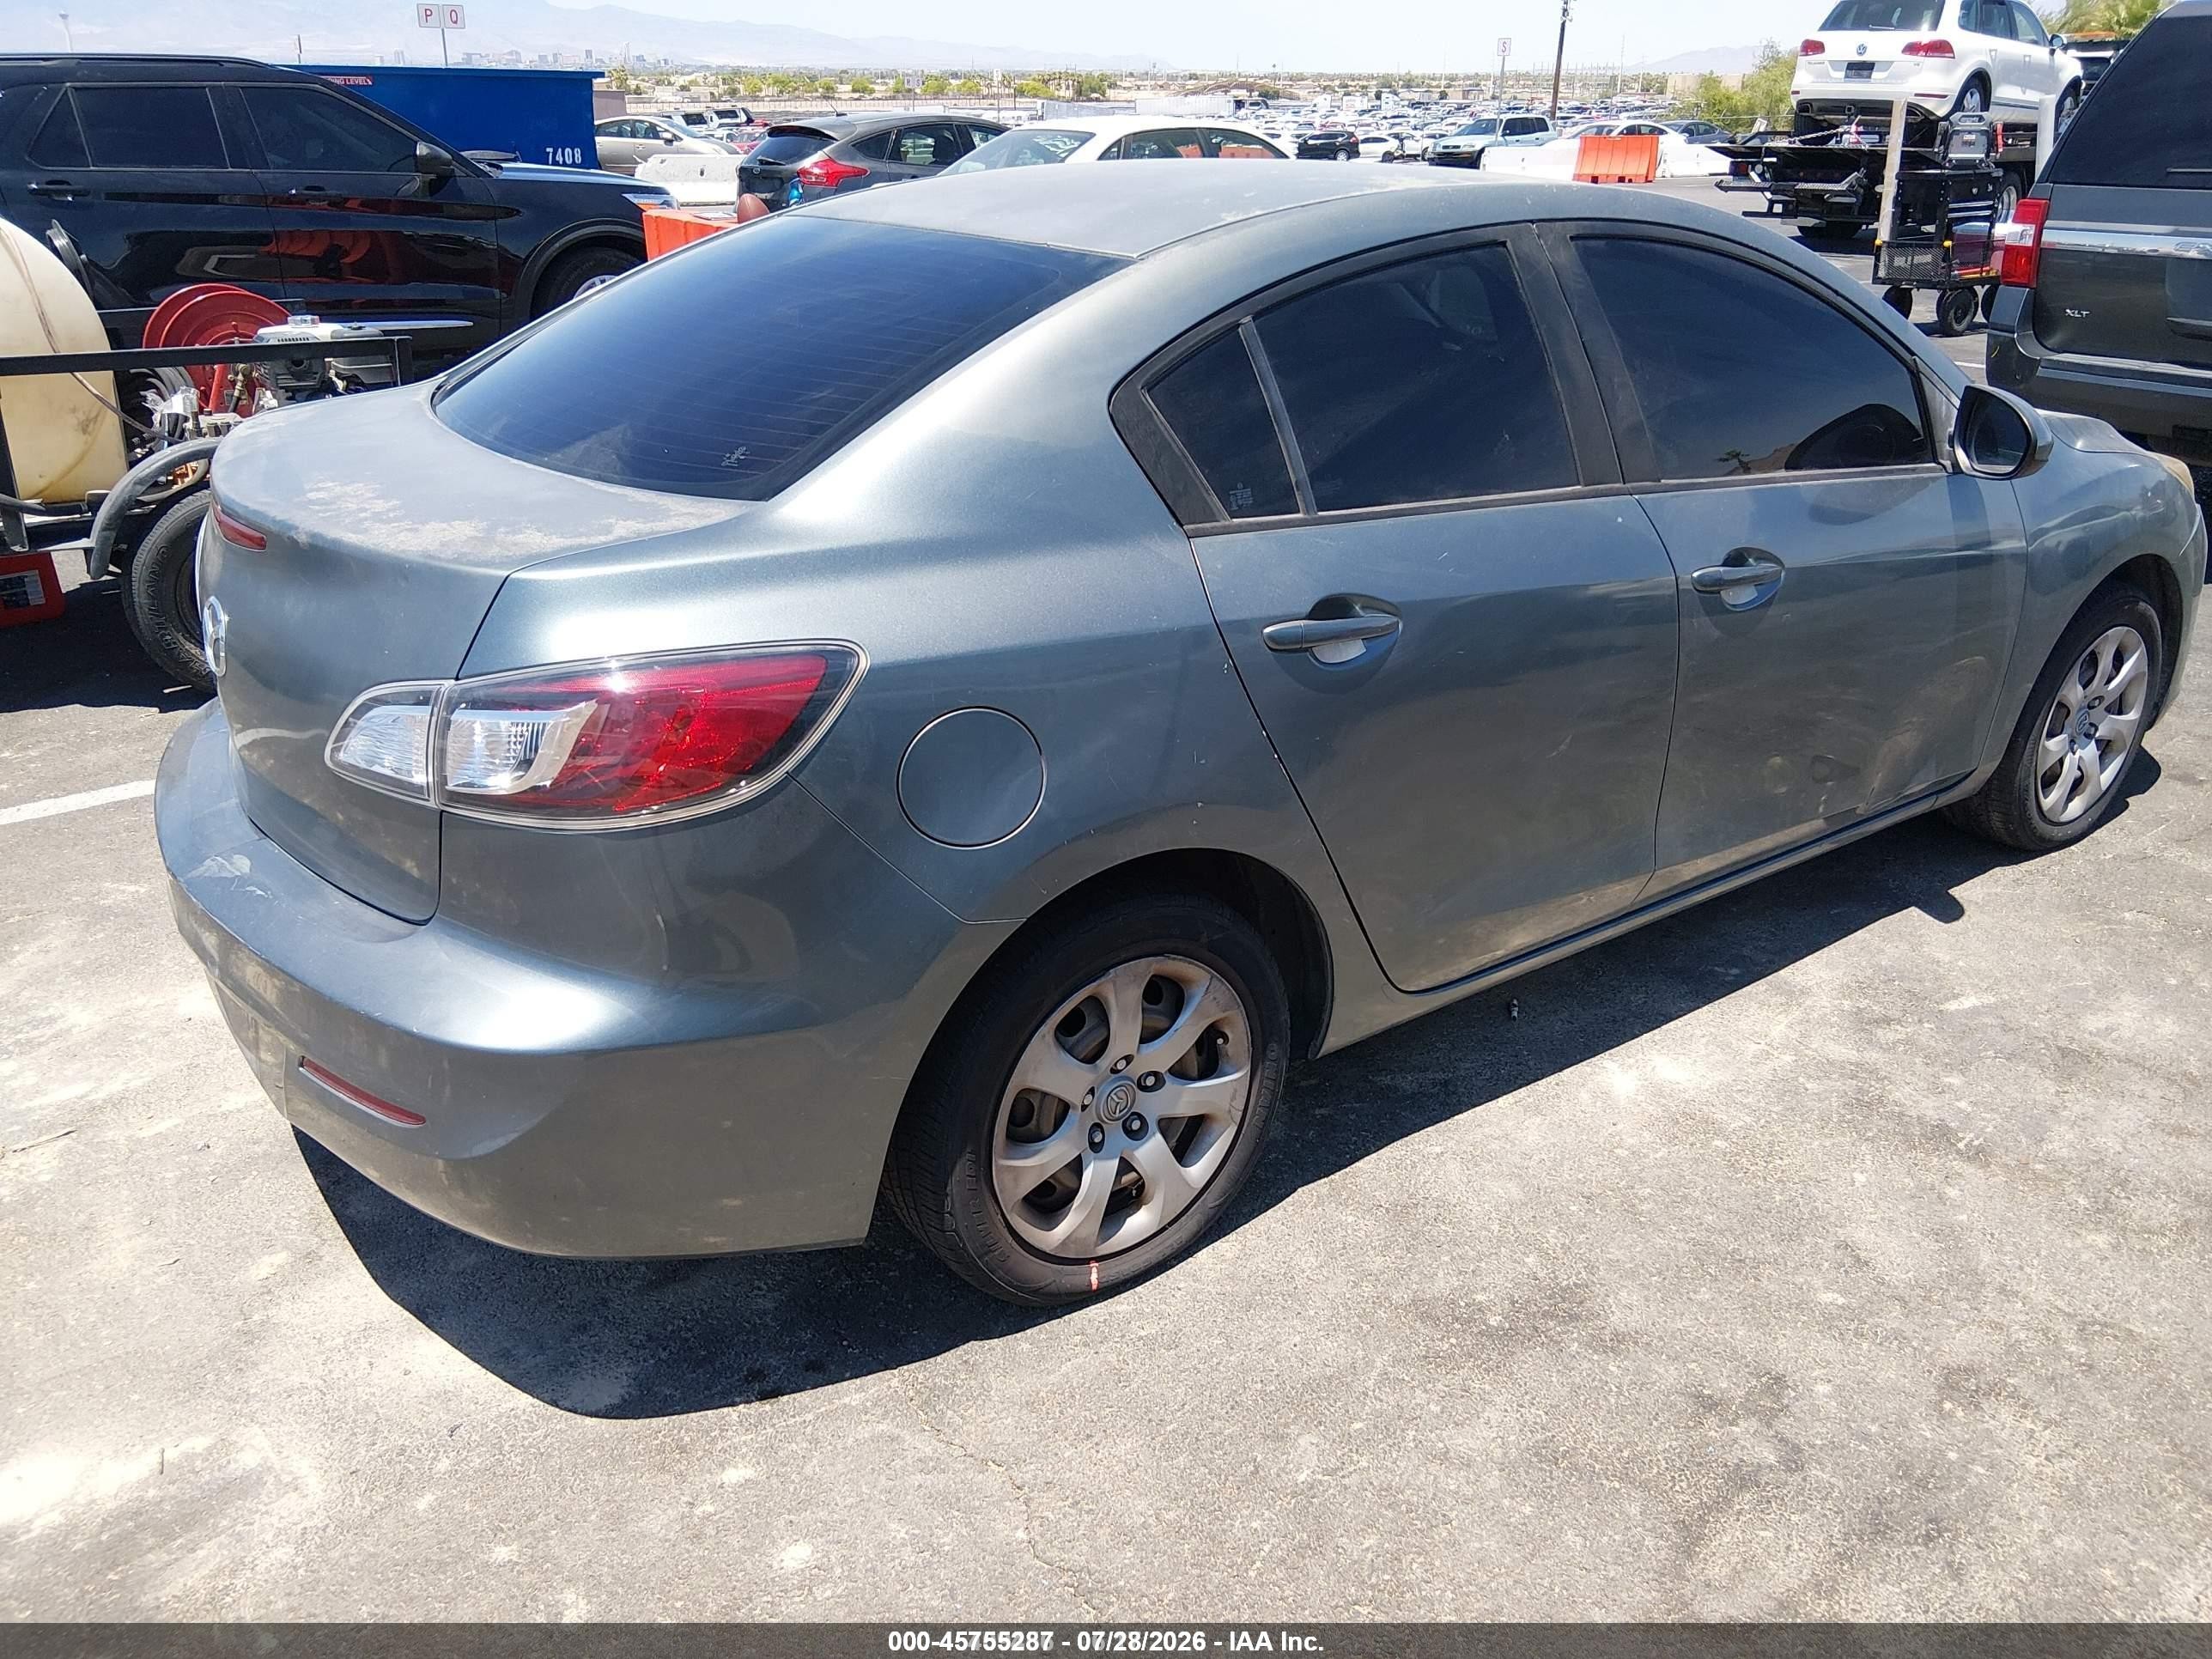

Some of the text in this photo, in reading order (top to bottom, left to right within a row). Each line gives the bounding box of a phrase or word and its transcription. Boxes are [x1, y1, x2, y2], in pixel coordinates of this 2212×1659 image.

[424, 9, 459, 24] P Q
[1502, 41, 1507, 52] S
[545, 147, 582, 165] 7408
[2065, 308, 2090, 318] XLT
